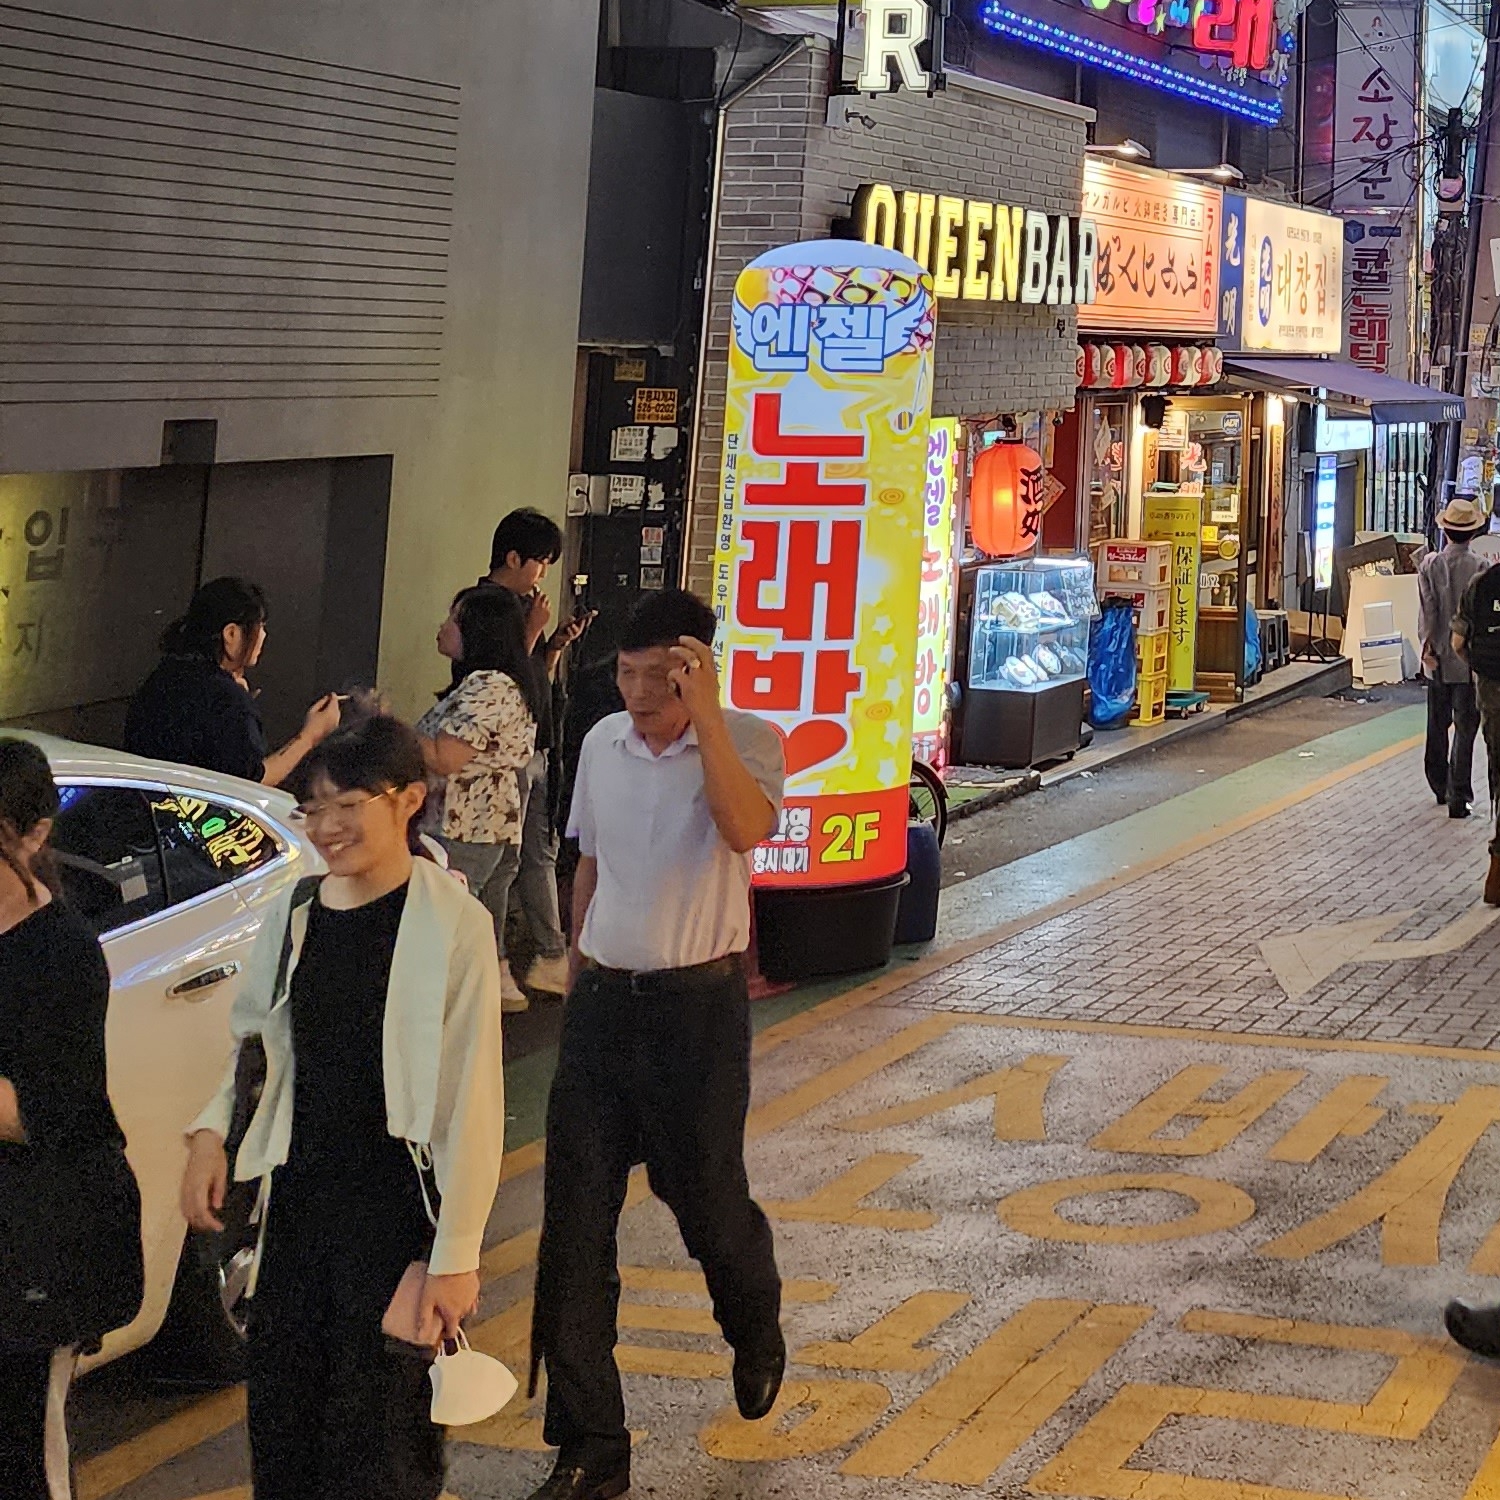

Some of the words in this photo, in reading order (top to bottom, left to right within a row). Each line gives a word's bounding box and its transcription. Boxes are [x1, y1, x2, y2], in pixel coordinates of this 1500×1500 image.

[1276, 247, 1328, 318] 대창집
[751, 300, 888, 374] 엔젤
[1173, 546, 1196, 654] 保証します。
[820, 812, 880, 864] 2F
